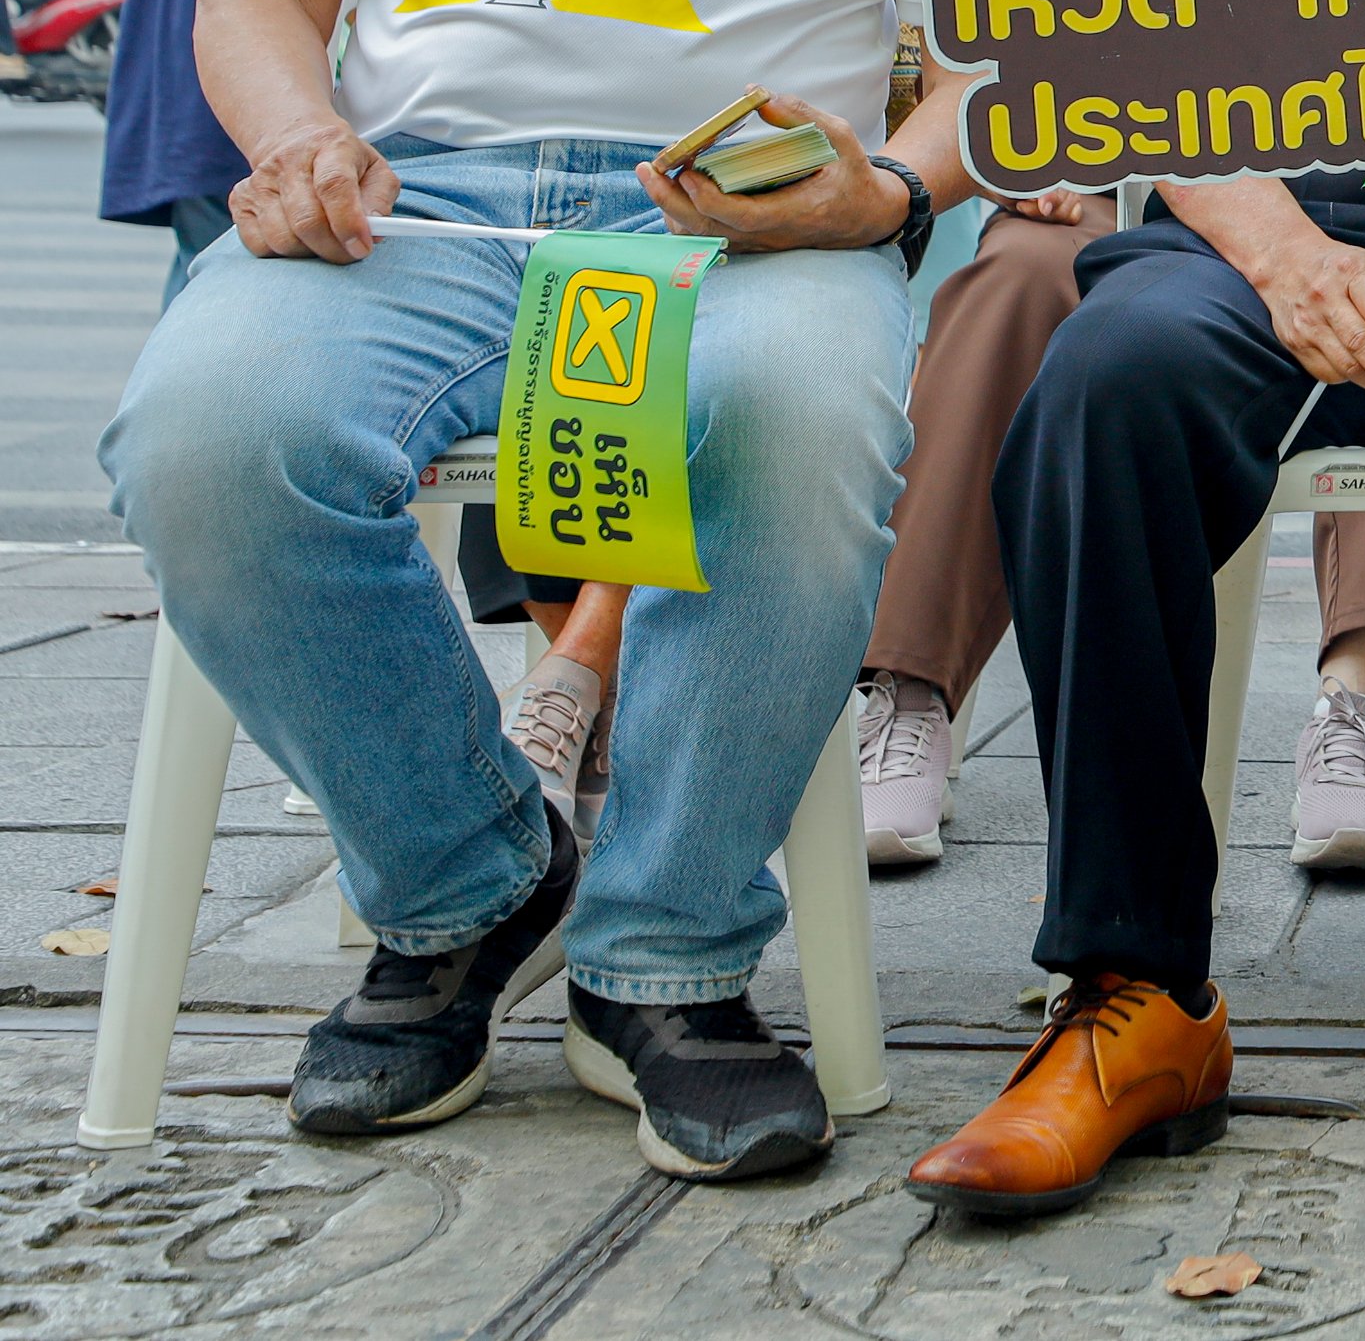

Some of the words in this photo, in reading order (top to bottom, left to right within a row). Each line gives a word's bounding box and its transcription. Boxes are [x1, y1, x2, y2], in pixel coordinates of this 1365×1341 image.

[516, 270, 560, 529] จัดทำรัฐธรรมนูญฉบับใหม่
[443, 469, 497, 482] SAHAC
[549, 417, 587, 546] ชอบ
[595, 433, 649, 543] เห็น
